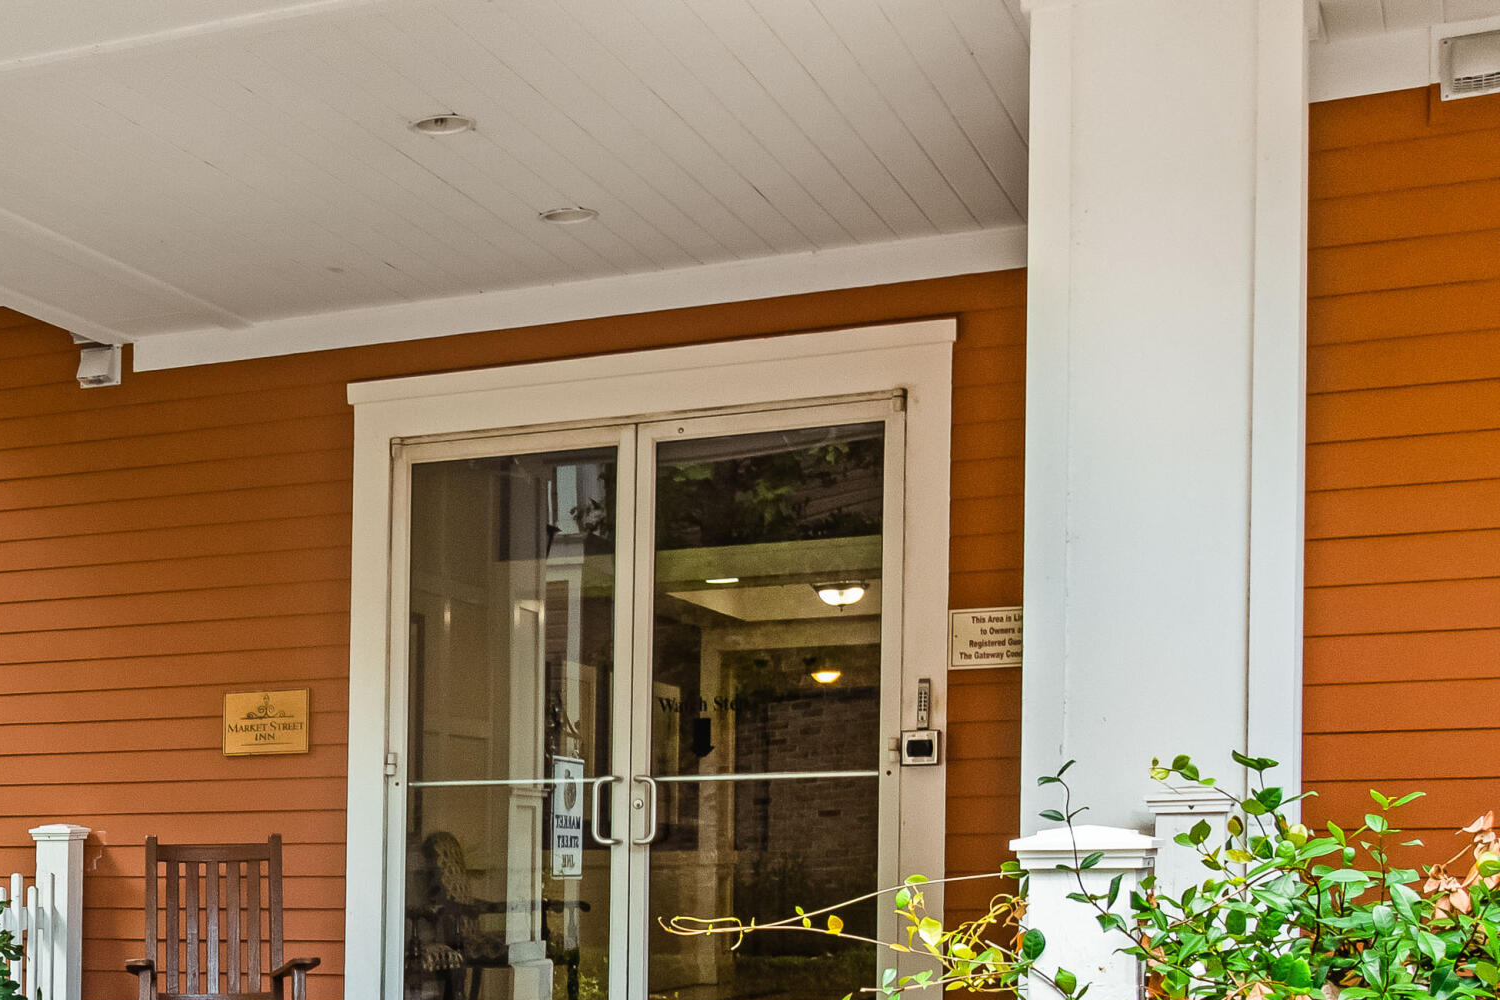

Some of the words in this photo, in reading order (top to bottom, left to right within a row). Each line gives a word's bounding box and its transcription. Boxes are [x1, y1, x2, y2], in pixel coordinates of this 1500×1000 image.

[971, 616, 986, 624] This
[988, 615, 1004, 623] Area
[1005, 614, 1012, 622] is
[1013, 613, 1023, 622] Li
[989, 627, 1015, 635] Owners
[969, 638, 1006, 649] Registered
[959, 652, 972, 660] The
[974, 651, 1004, 661] Gateway
[657, 696, 708, 712] Wah
[228, 723, 268, 733] MARKET
[269, 721, 304, 731] STREET
[255, 733, 276, 741] INN
